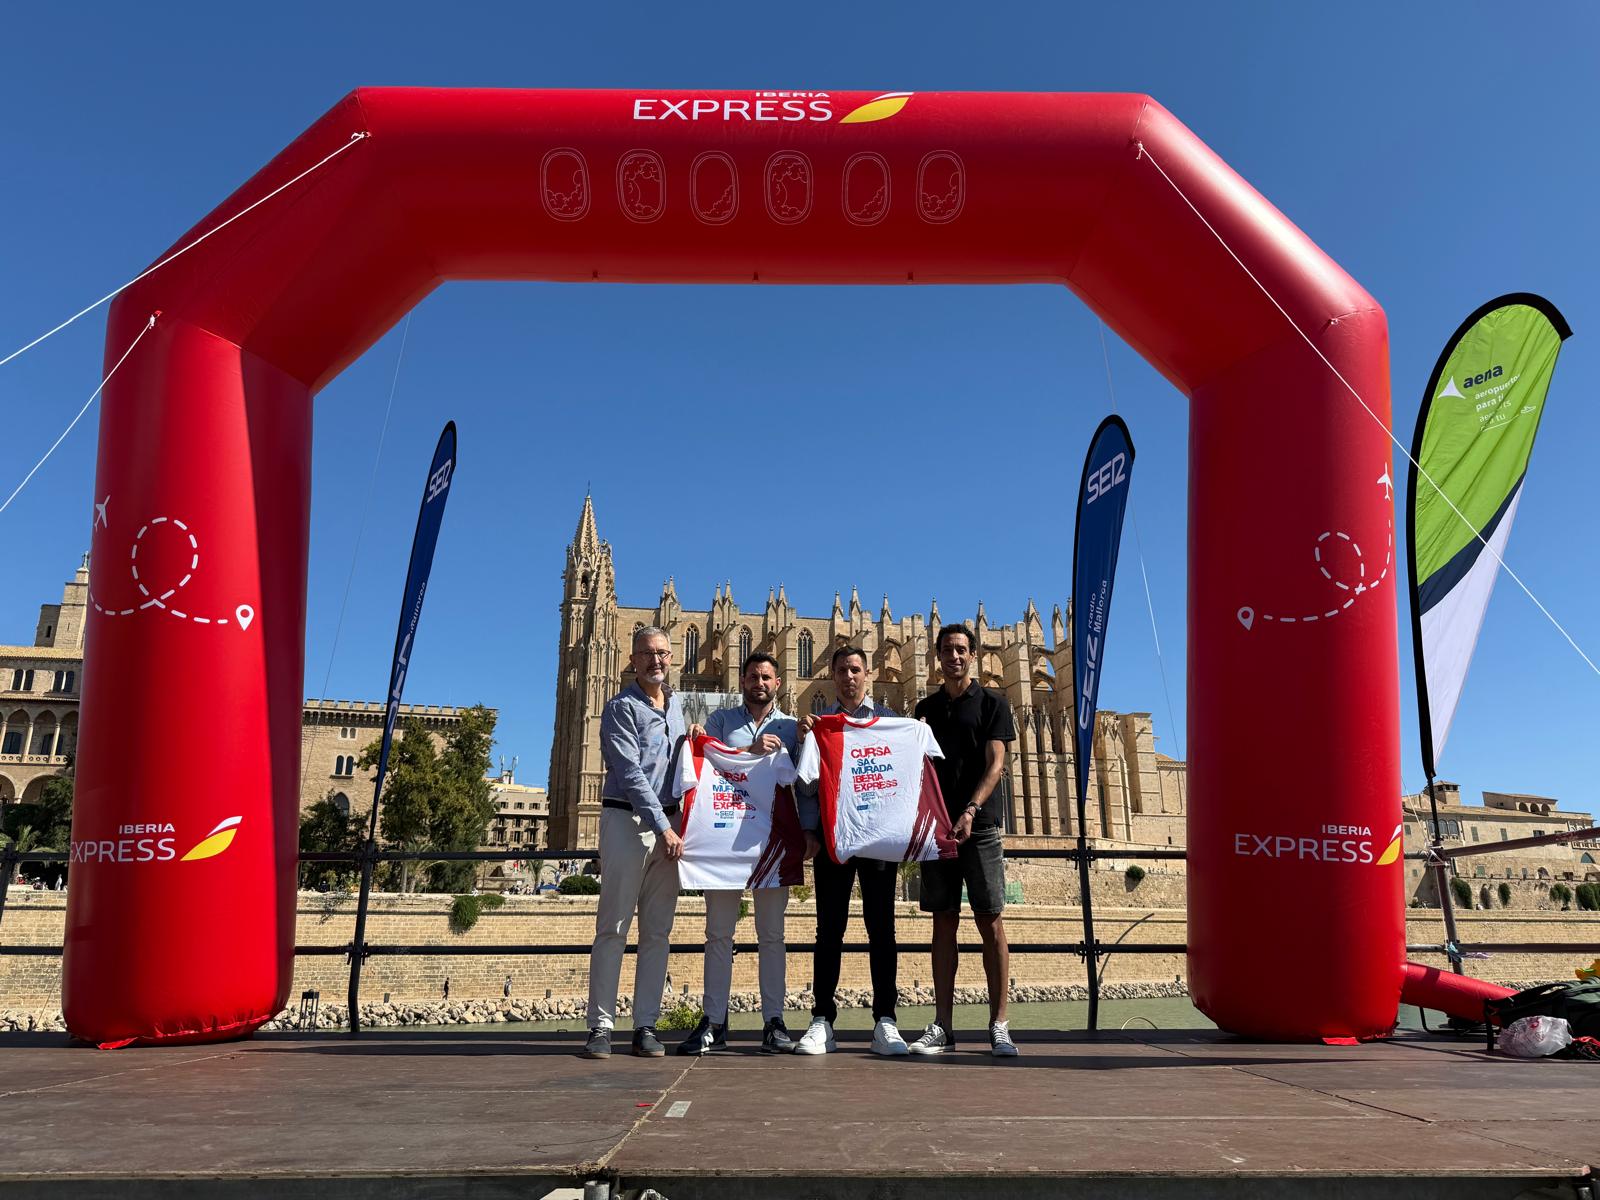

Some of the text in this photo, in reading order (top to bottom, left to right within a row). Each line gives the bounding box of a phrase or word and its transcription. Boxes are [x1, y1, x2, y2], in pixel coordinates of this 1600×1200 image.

[633, 99, 833, 121] EXPRESS
[1463, 365, 1503, 389] aena
[1476, 398, 1497, 413] para
[1093, 580, 1107, 633] Mallorca
[851, 746, 892, 759] CURSA
[713, 768, 749, 782] CRSA
[851, 764, 893, 775] MURADA
[853, 773, 884, 784] IBERIA
[854, 779, 898, 792] EXPRESS
[713, 802, 757, 811] EXPRESS
[119, 823, 176, 835] IBERIA
[1321, 824, 1372, 836] IBERIA
[1234, 833, 1373, 864] EXPRESS
